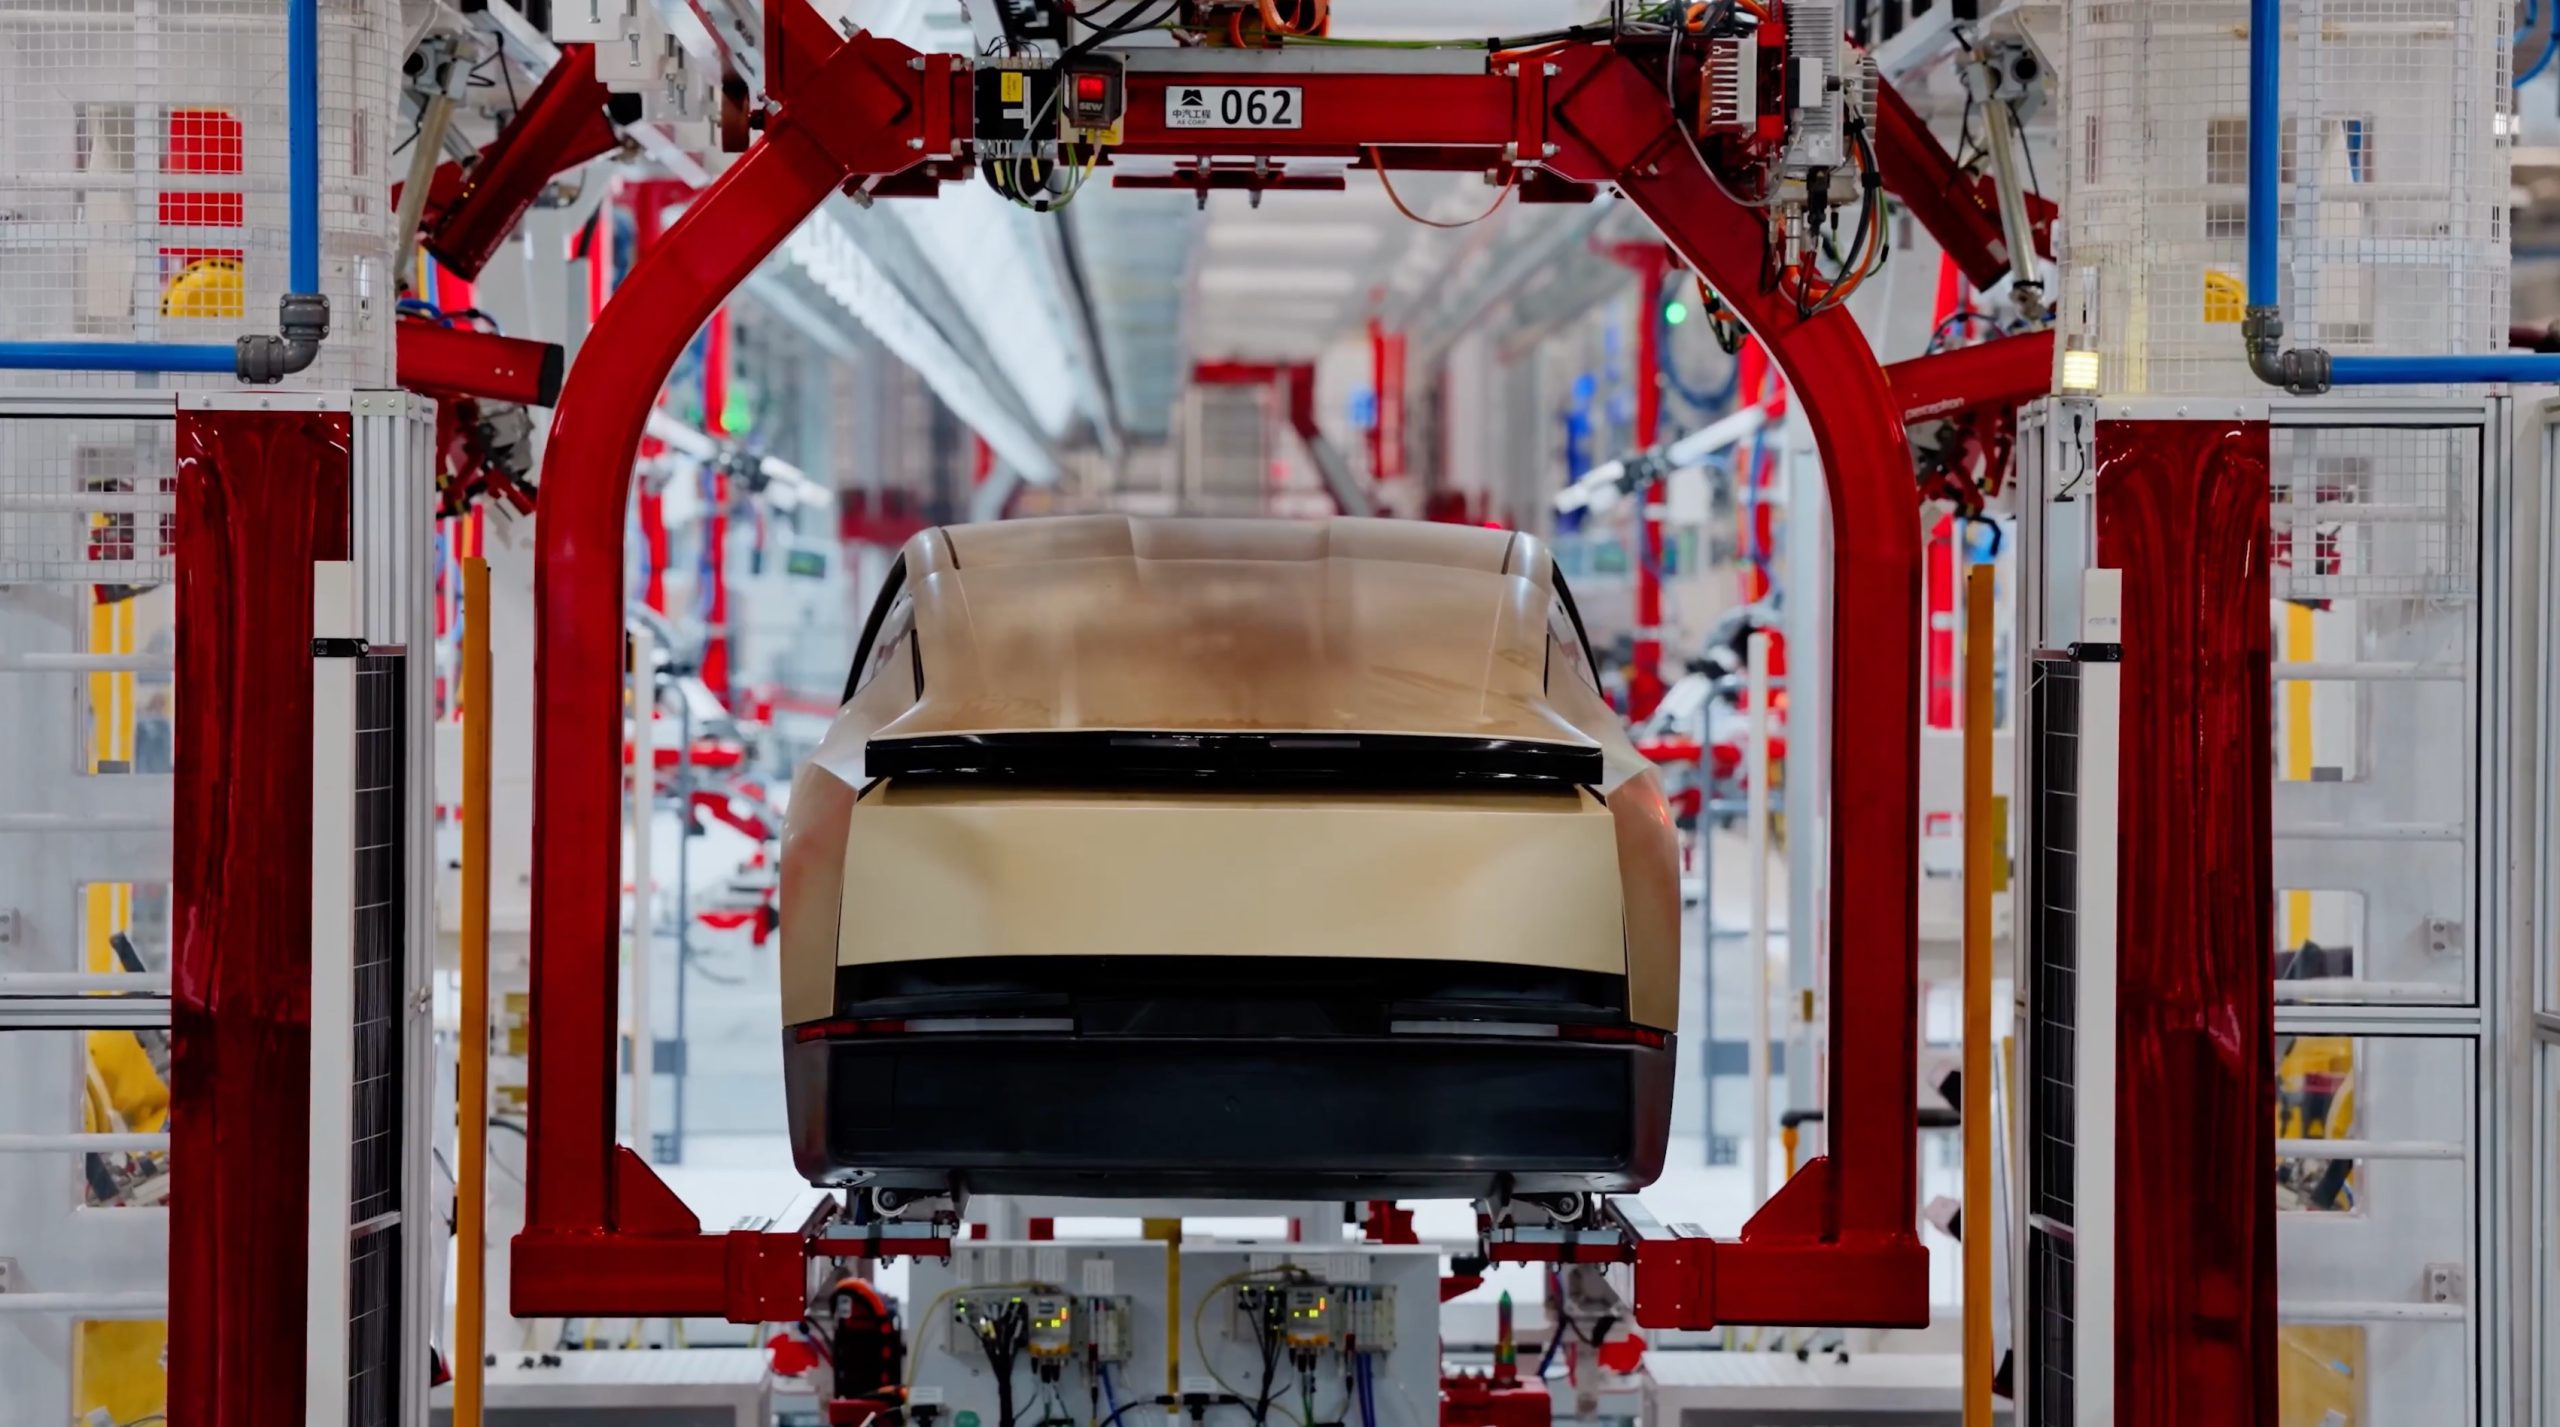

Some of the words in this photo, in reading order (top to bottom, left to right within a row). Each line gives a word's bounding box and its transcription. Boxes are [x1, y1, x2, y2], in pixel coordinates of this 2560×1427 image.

[1079, 102, 1103, 111] SEW
[1221, 89, 1292, 125] 062
[1172, 109, 1211, 119] 中汽工程
